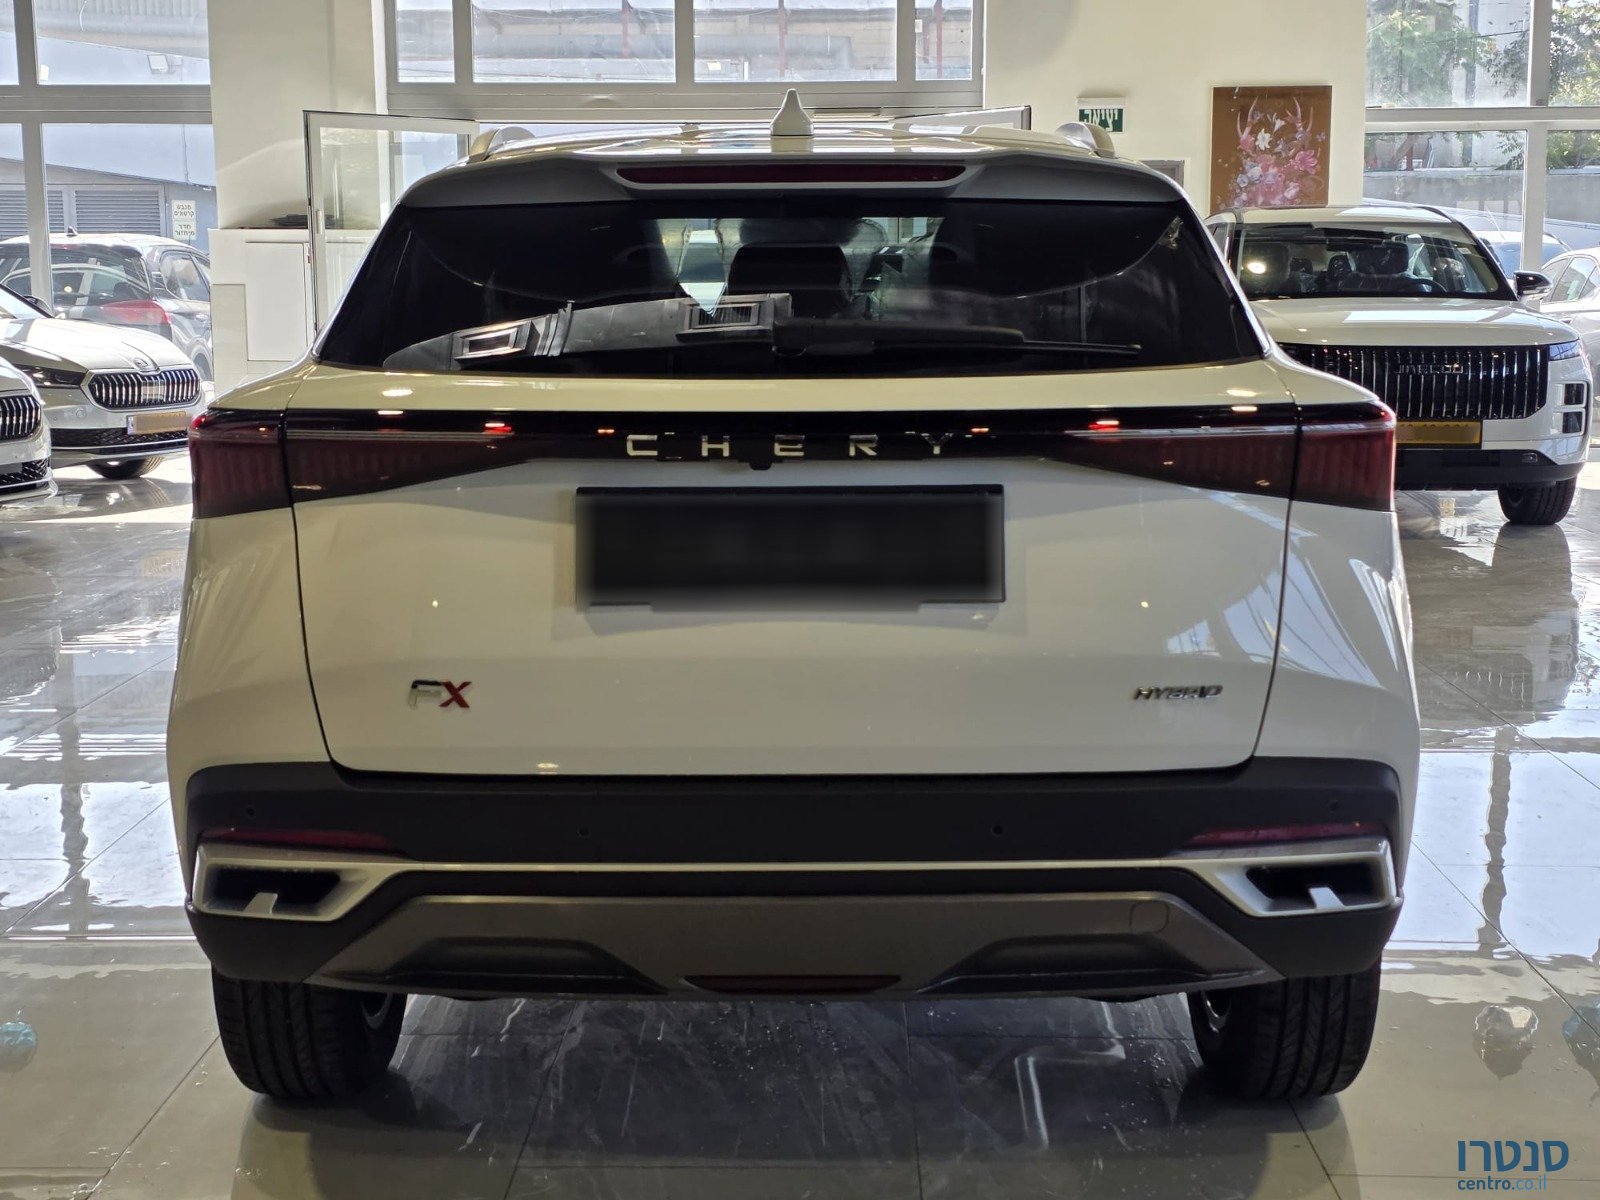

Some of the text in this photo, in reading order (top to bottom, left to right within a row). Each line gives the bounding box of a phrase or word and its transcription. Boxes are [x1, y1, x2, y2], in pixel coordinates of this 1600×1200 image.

[626, 432, 954, 457] CHERY
[408, 679, 472, 709] FX
[1132, 684, 1223, 700] HYBRID
